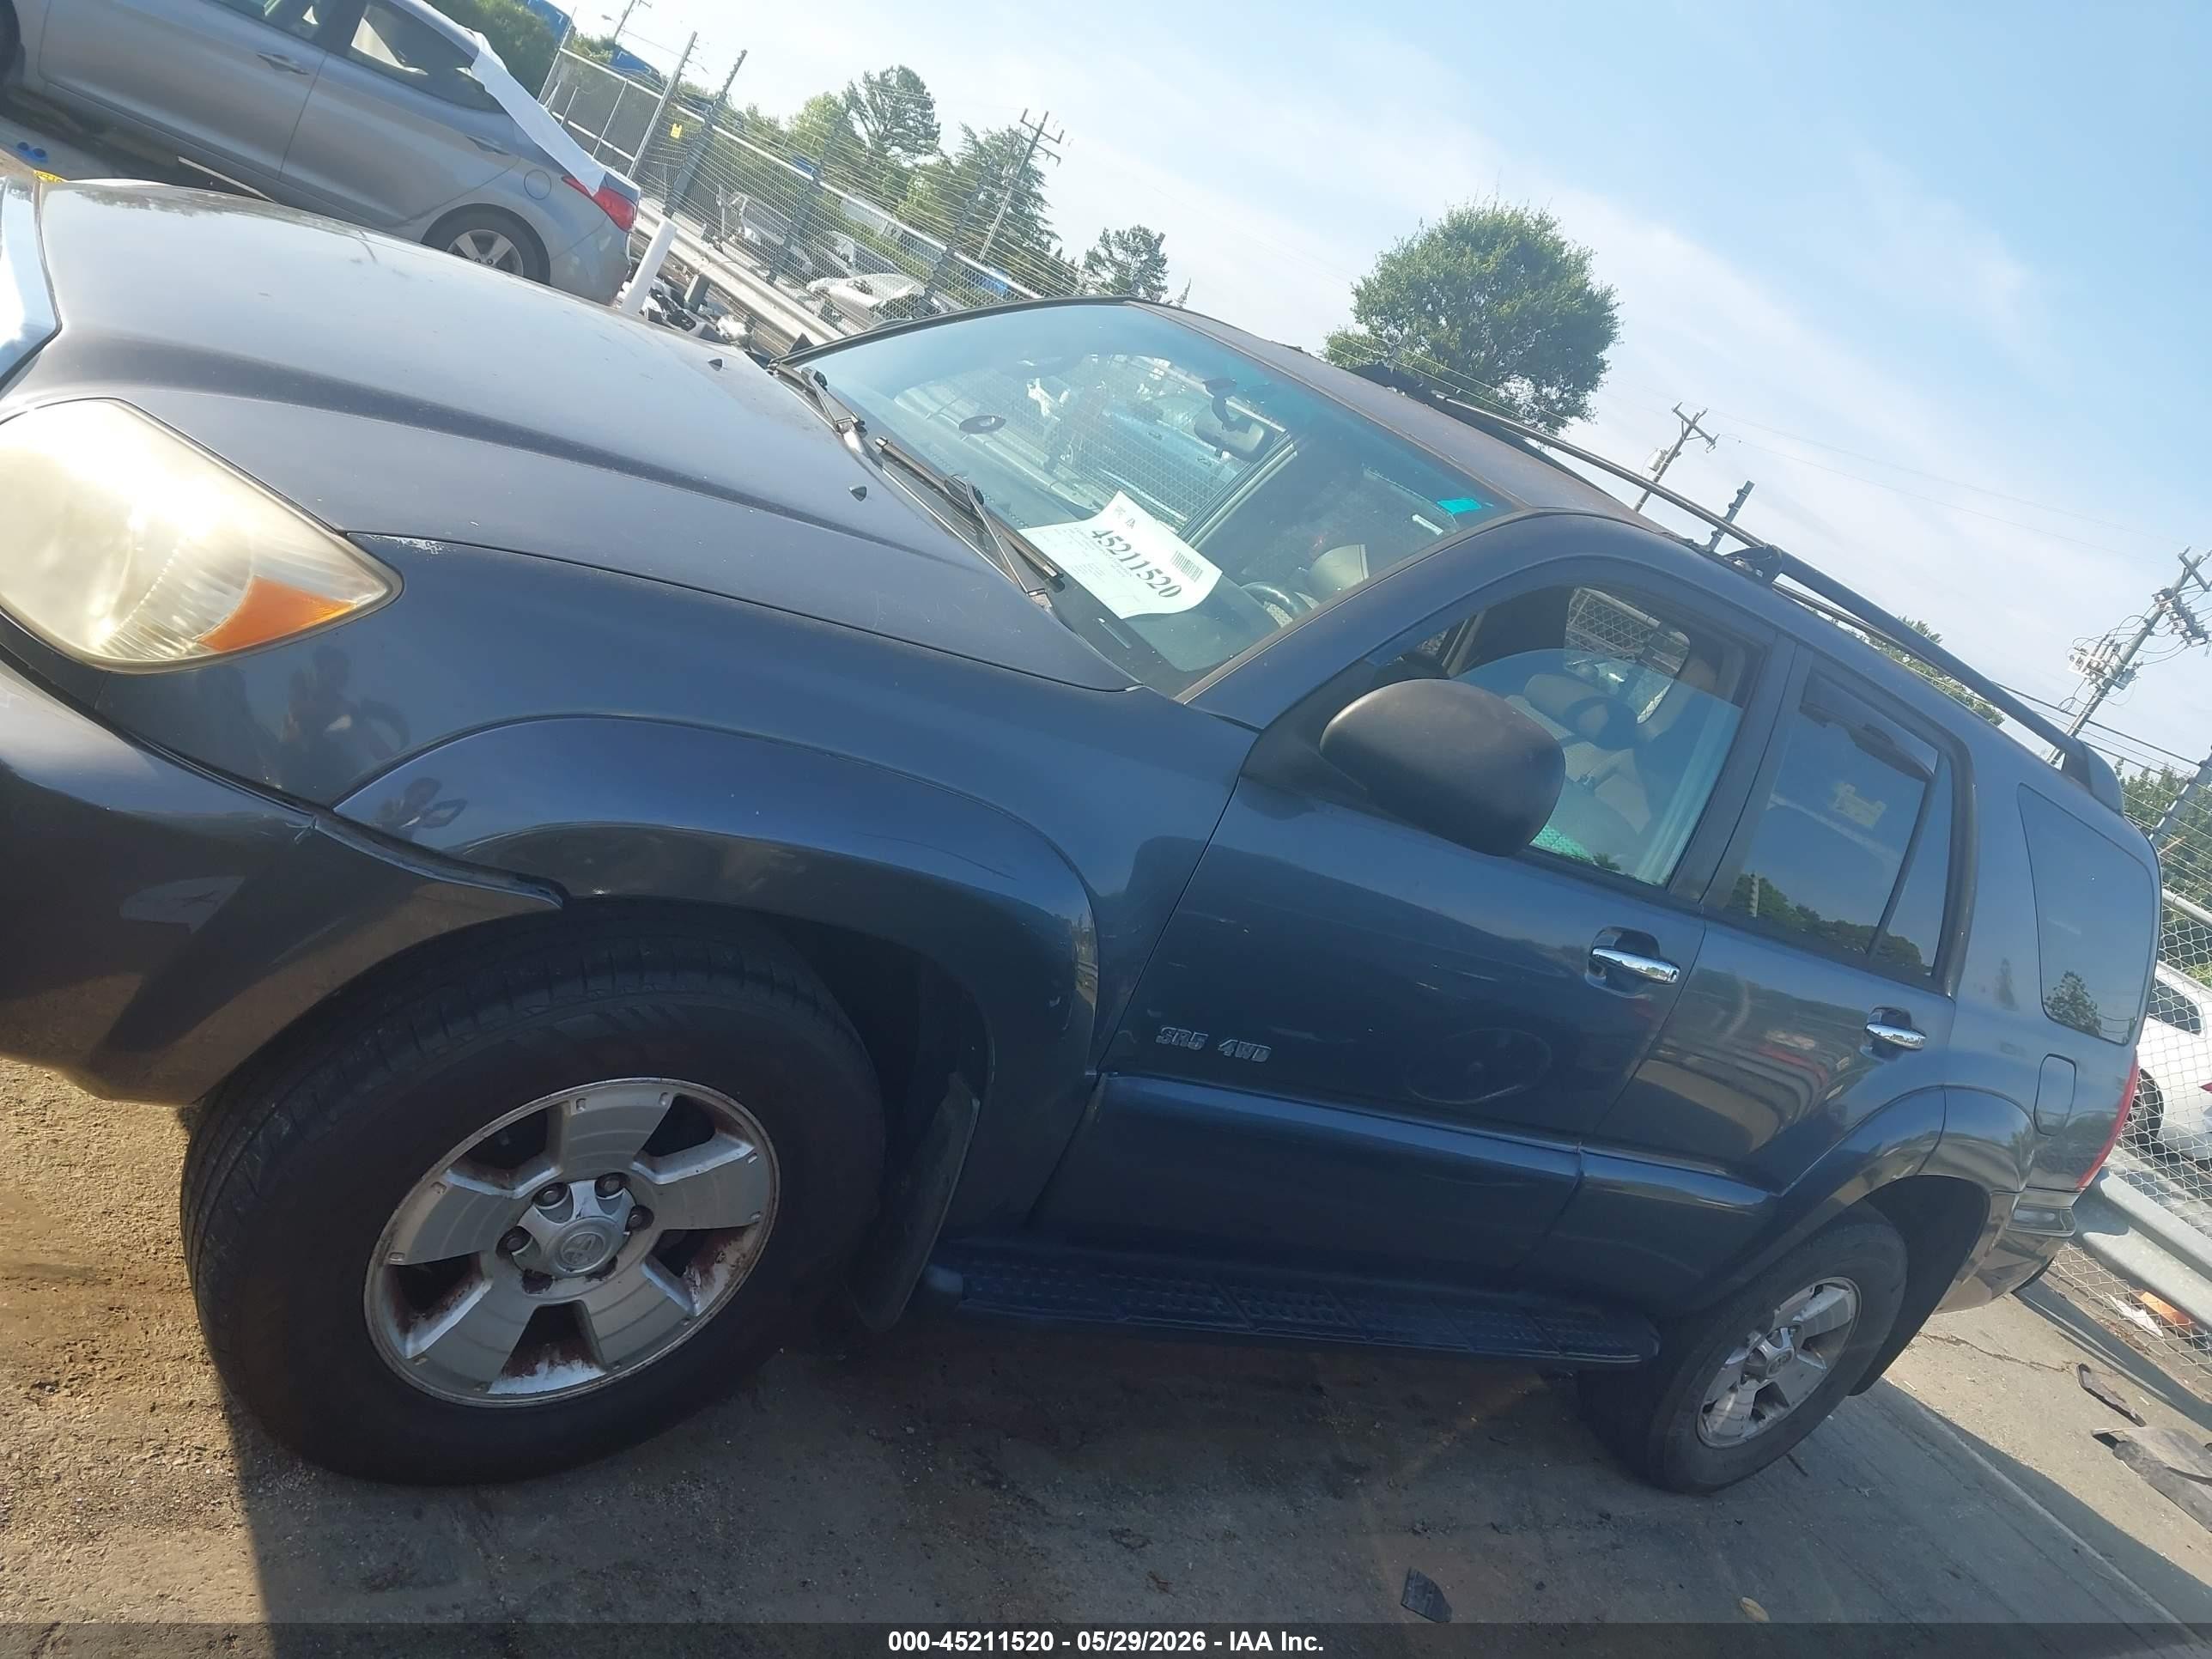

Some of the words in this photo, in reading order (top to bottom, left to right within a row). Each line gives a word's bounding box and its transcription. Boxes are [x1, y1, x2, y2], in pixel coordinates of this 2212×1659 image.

[1091, 528, 1182, 598] 45211520
[1156, 1026, 1209, 1050] SR5
[1218, 1039, 1272, 1062] 4WD
